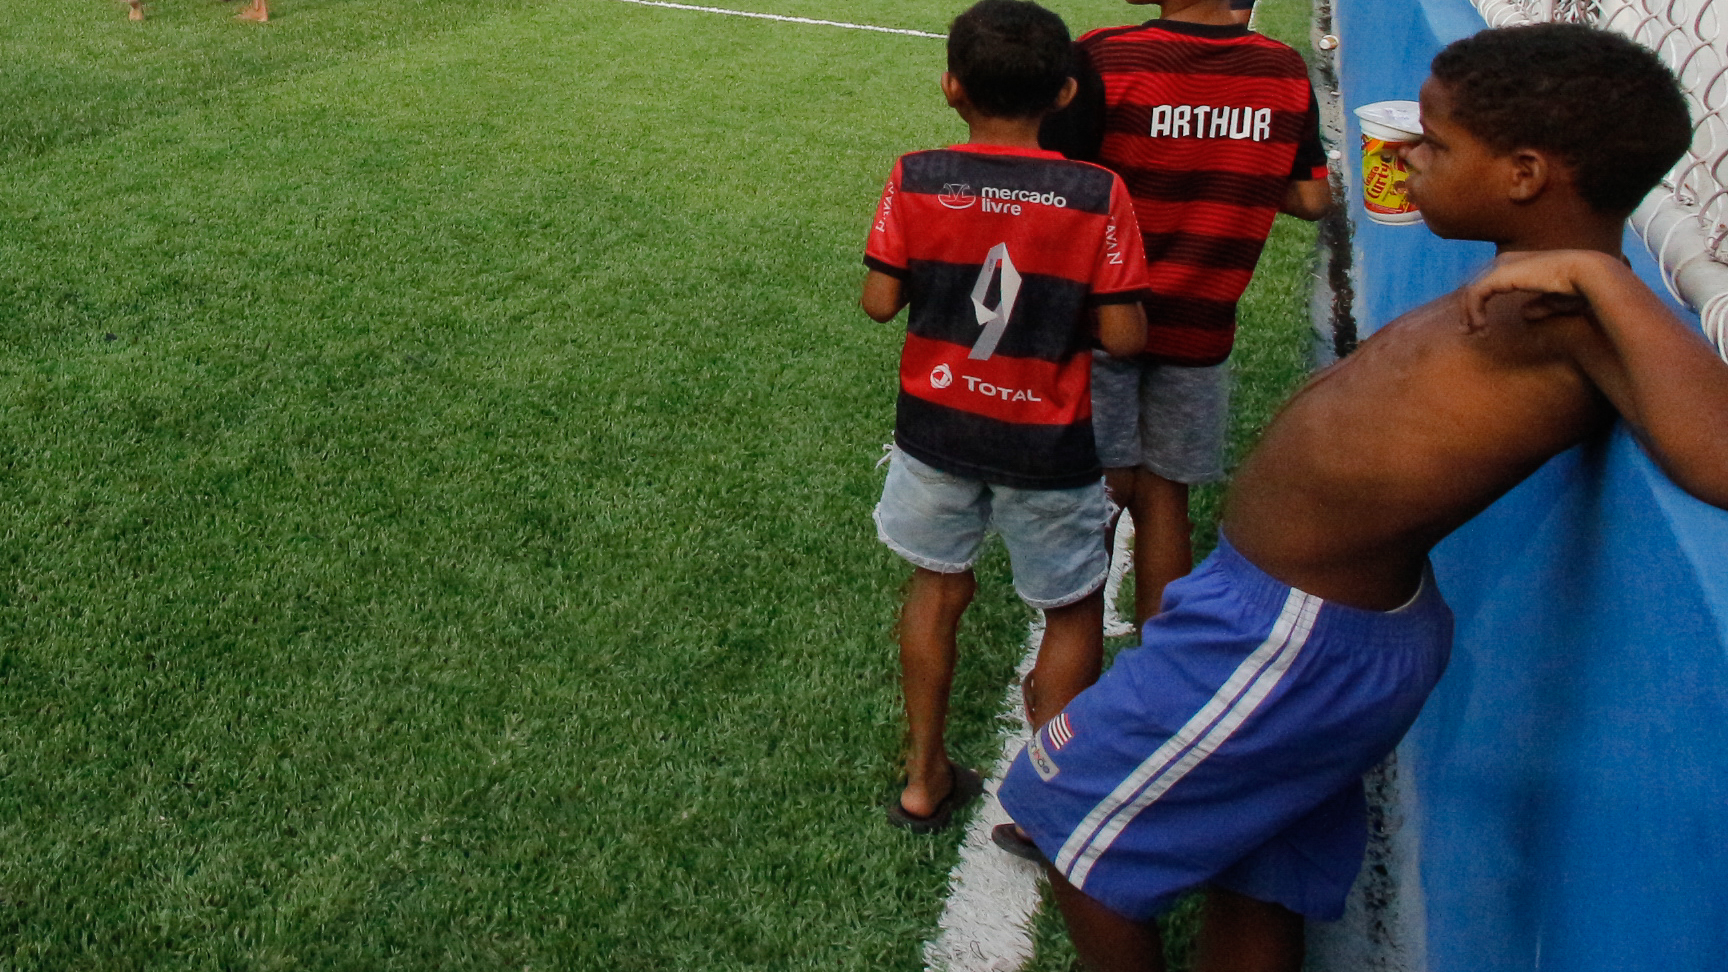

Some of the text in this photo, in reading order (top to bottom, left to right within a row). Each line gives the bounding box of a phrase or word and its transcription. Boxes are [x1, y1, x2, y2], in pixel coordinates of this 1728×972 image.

[1150, 104, 1272, 142] ARTHUR
[981, 186, 1067, 209] mercado
[981, 197, 1022, 216] livre
[967, 242, 1022, 361] 9
[961, 374, 1042, 403] TOTAL
